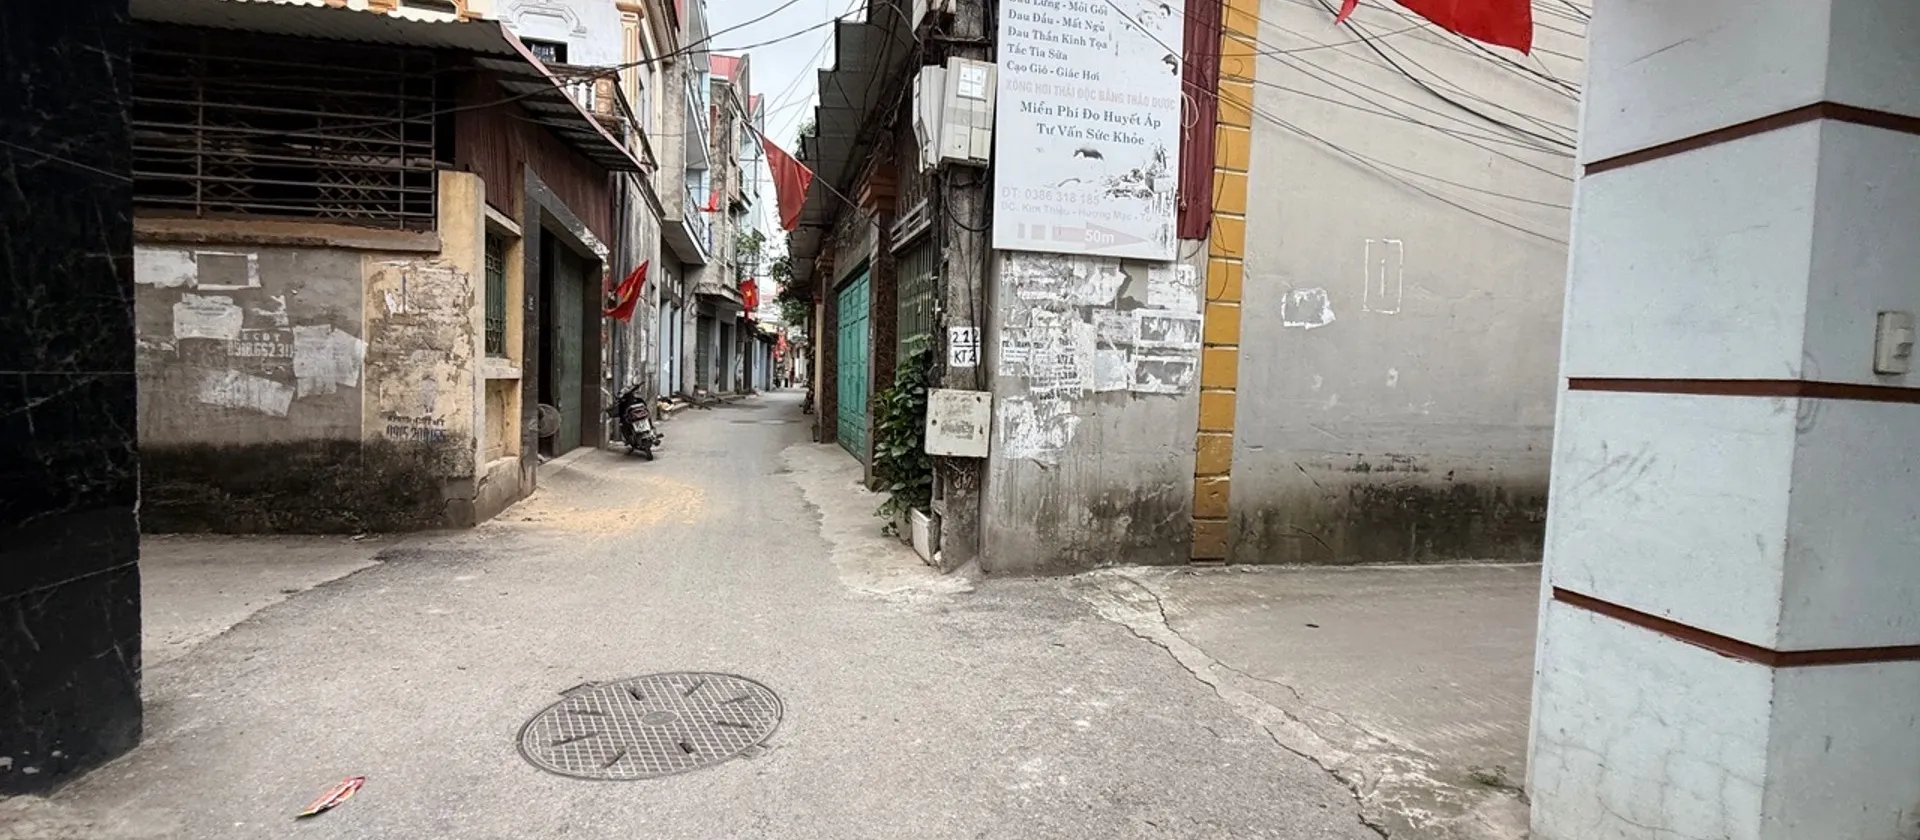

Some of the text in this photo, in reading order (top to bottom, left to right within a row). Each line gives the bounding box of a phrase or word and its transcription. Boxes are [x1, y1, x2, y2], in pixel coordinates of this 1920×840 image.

[1061, 33, 1086, 46] Kinh
[1029, 46, 1046, 58] Tia
[1006, 60, 1027, 74] Cạo
[1029, 62, 1048, 75] Gió
[1056, 66, 1080, 79] Giác
[1057, 105, 1079, 118] Phí
[1082, 107, 1100, 121] Đo
[1103, 110, 1141, 126] Huyết
[1144, 113, 1161, 130] Áp
[1036, 122, 1145, 146] Tư Vấn Sức Khỏe
[1024, 188, 1053, 201] 0386
[1084, 229, 1114, 244] 50m
[954, 350, 976, 364] KT2
